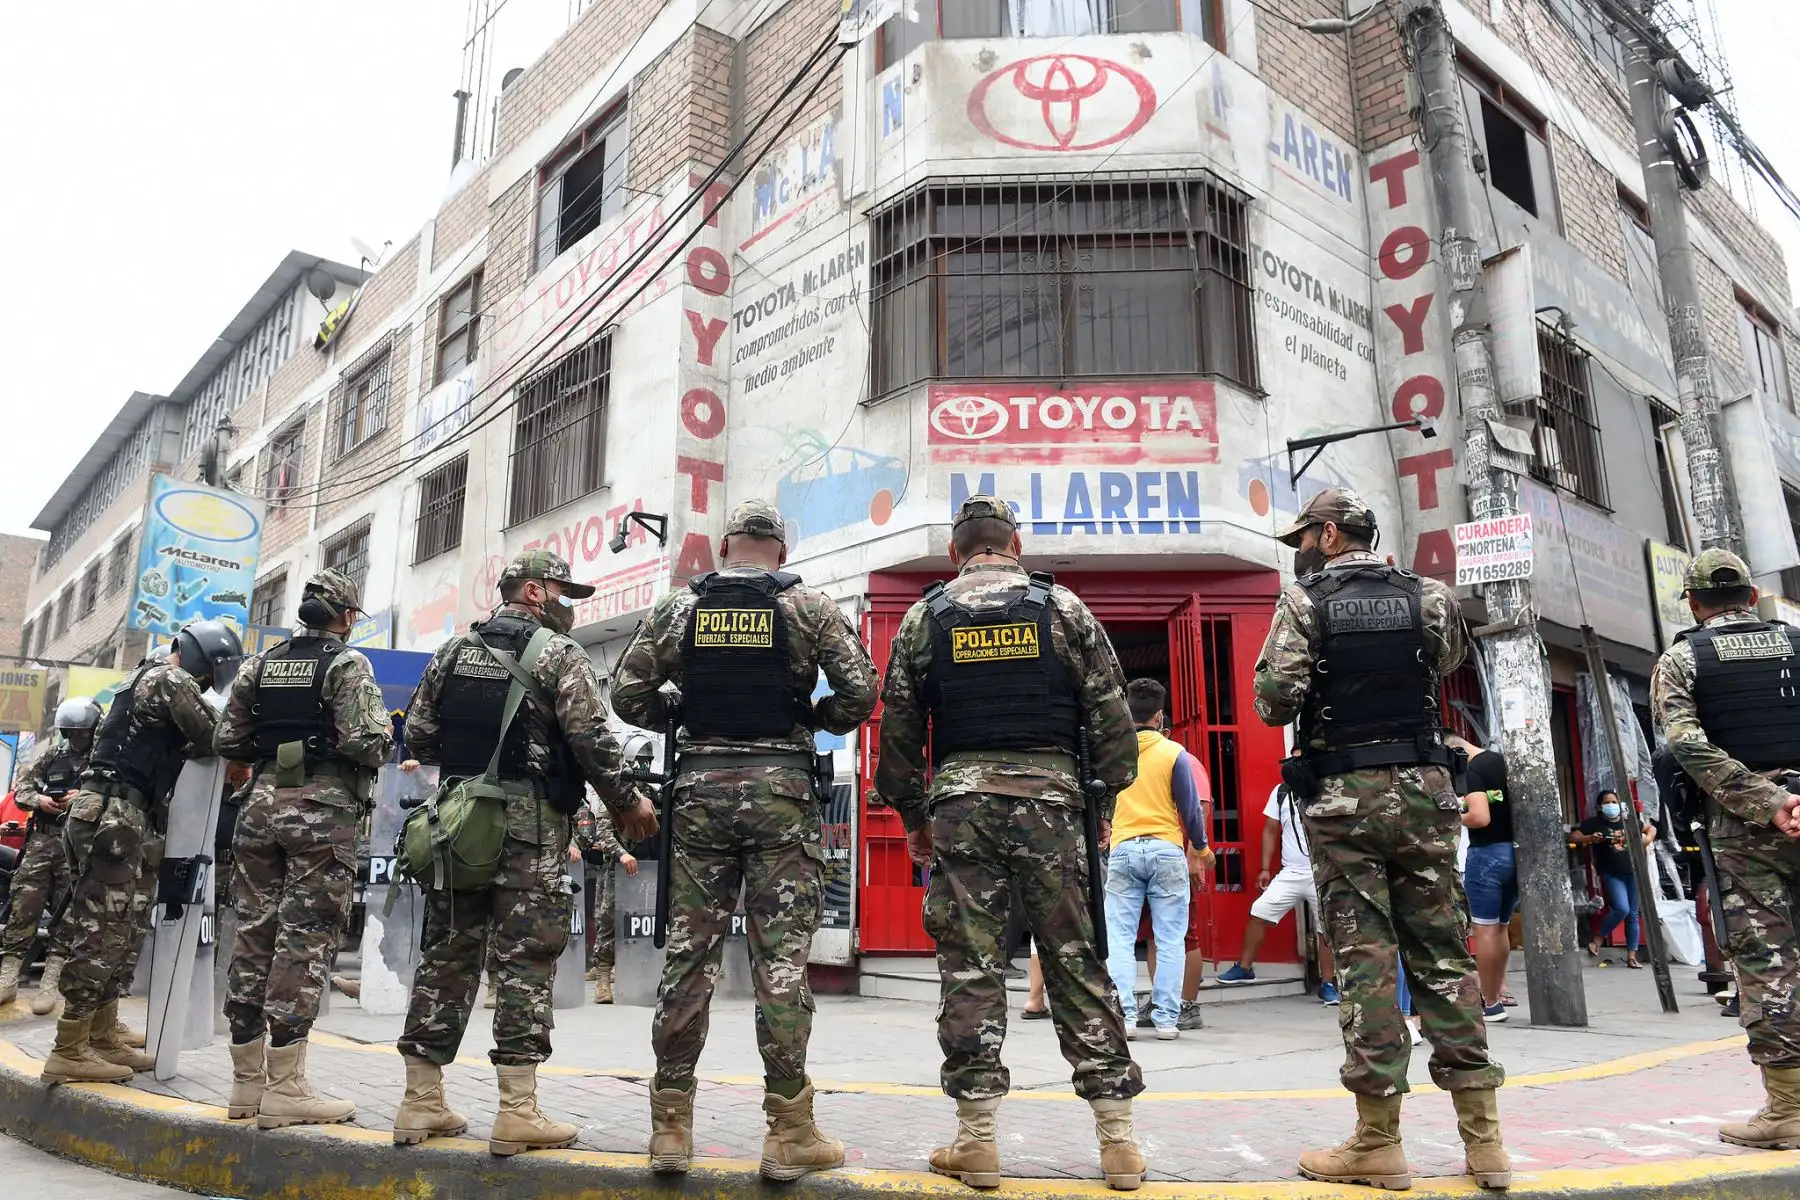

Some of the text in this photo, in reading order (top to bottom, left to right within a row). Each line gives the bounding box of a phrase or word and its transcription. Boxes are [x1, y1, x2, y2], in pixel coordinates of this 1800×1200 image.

[1267, 112, 1352, 203] AREN
[1250, 242, 1326, 307] TOYOTA
[733, 241, 865, 334] TOYOTA McLAREN
[735, 307, 820, 364] comprometidos
[825, 292, 846, 317] con
[1256, 286, 1376, 364] responsabilidad con
[745, 336, 835, 395] medio ambiente
[1285, 335, 1347, 381] el planeta
[1368, 150, 1456, 588] TOYOTA
[671, 172, 736, 588] TOYOTA
[1009, 396, 1203, 430] TOYOTA
[1457, 516, 1530, 541] CURANDERA
[1469, 535, 1516, 556] NORTEÑA
[159, 546, 241, 570] McLaren
[176, 559, 221, 573] AUTOMOTRIZ
[1459, 560, 1531, 583] 971659289
[573, 583, 655, 628] ERVICIO
[1333, 600, 1406, 618] POLICIA
[699, 612, 769, 632] POLICIA
[1366, 616, 1411, 629] ESPECIALES
[698, 633, 769, 644] FUERZAS ESPECIALES
[954, 627, 1036, 649] POLICIA
[1713, 631, 1788, 650] POLICIA
[956, 645, 1036, 660] OPERACIONES ESPECIALES
[263, 662, 314, 677] POLICIA
[455, 664, 508, 678] FUERZAS ESPECIALES
